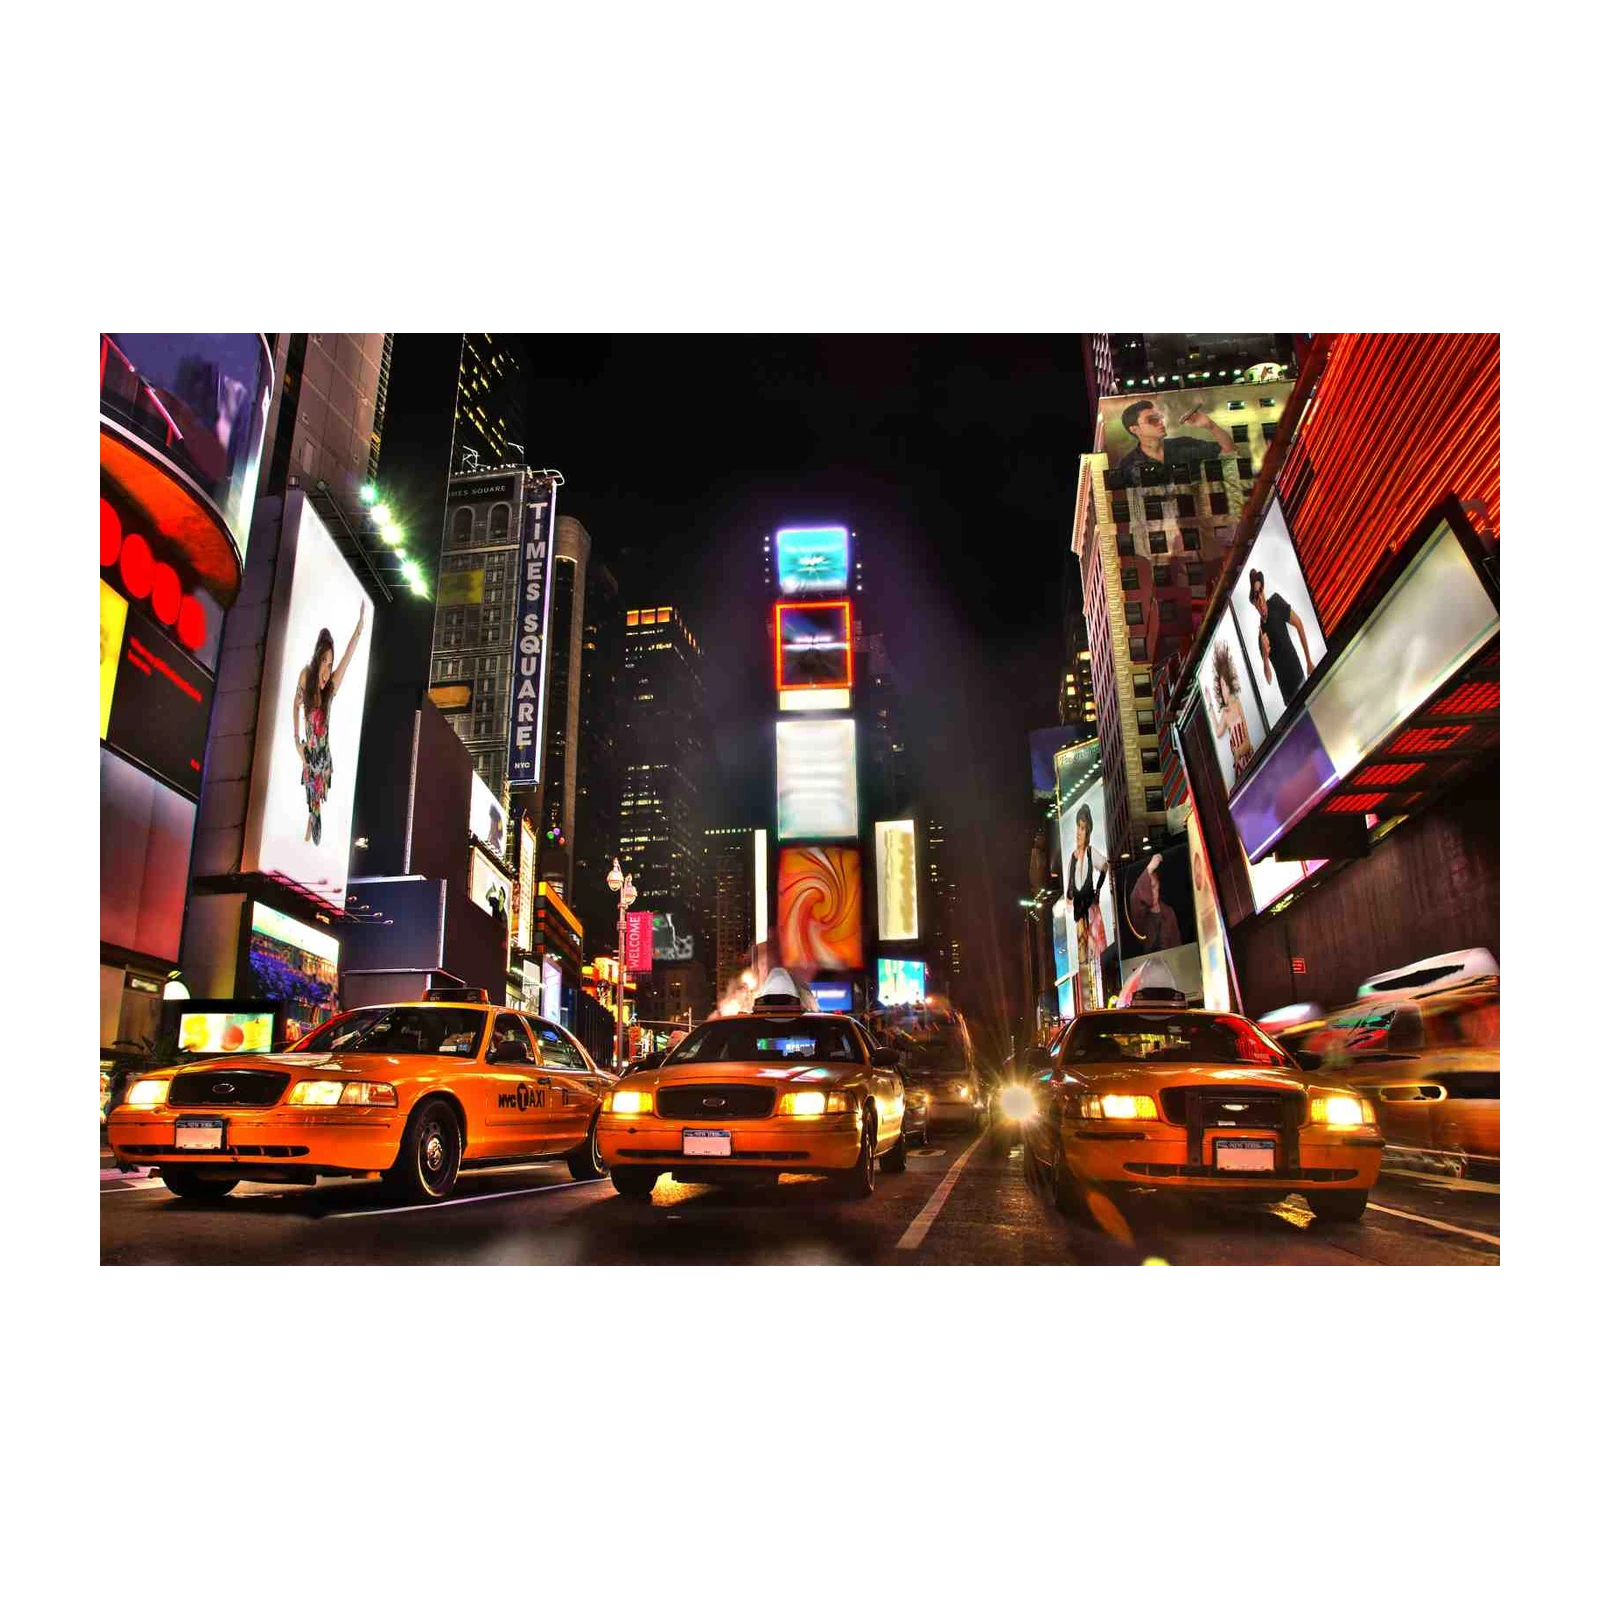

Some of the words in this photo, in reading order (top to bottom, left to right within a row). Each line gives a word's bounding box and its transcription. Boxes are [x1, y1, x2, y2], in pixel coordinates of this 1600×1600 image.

[472, 485, 506, 495] SQUARE
[526, 502, 548, 601] TIMES
[516, 613, 541, 746] SQUARE
[514, 761, 530, 769] NYC
[628, 916, 640, 969] WELCOME
[498, 1093, 516, 1109] NYC
[517, 1083, 545, 1112] TAXI
